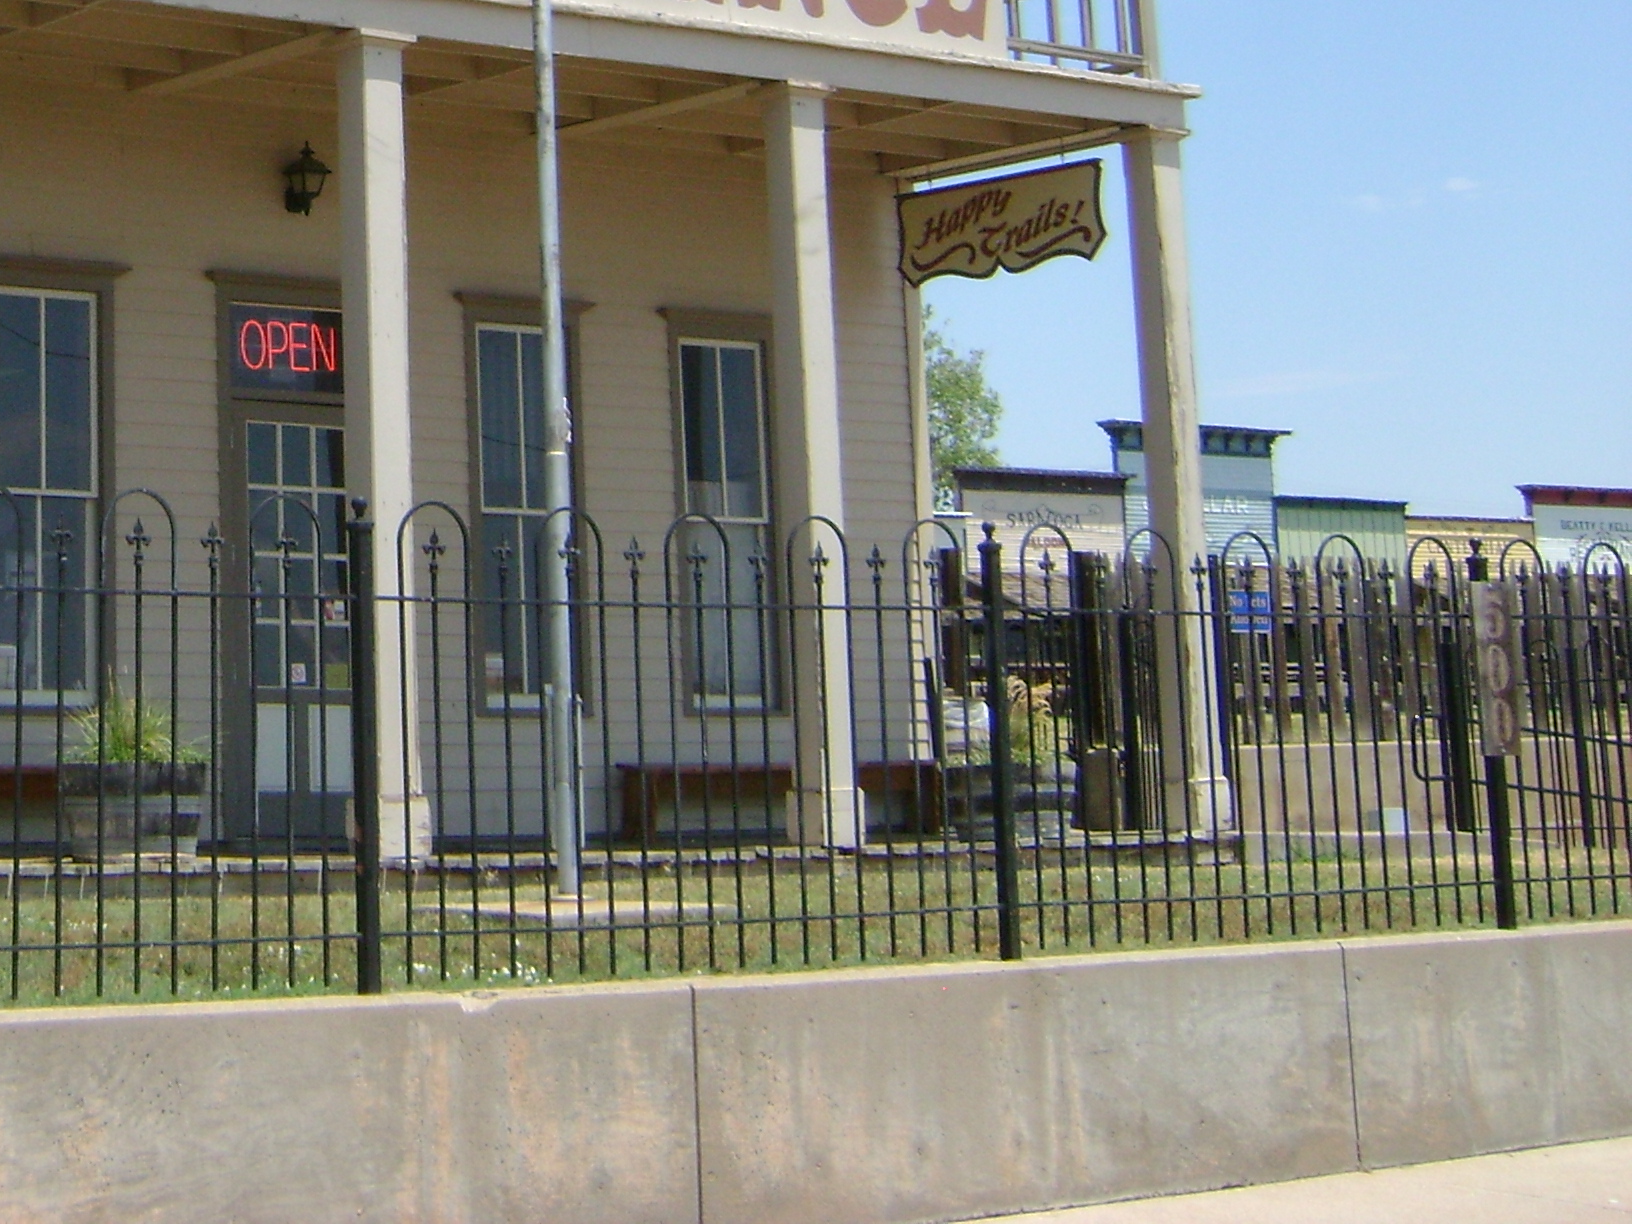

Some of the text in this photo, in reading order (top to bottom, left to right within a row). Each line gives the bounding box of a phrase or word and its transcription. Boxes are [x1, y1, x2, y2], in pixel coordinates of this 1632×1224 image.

[915, 188, 1013, 250] Happy
[976, 197, 1085, 258] Trails!
[239, 318, 336, 373] OPEN
[1005, 507, 1083, 530] SARATOGA
[1560, 519, 1596, 530] BEATTY
[1229, 594, 1243, 607] No
